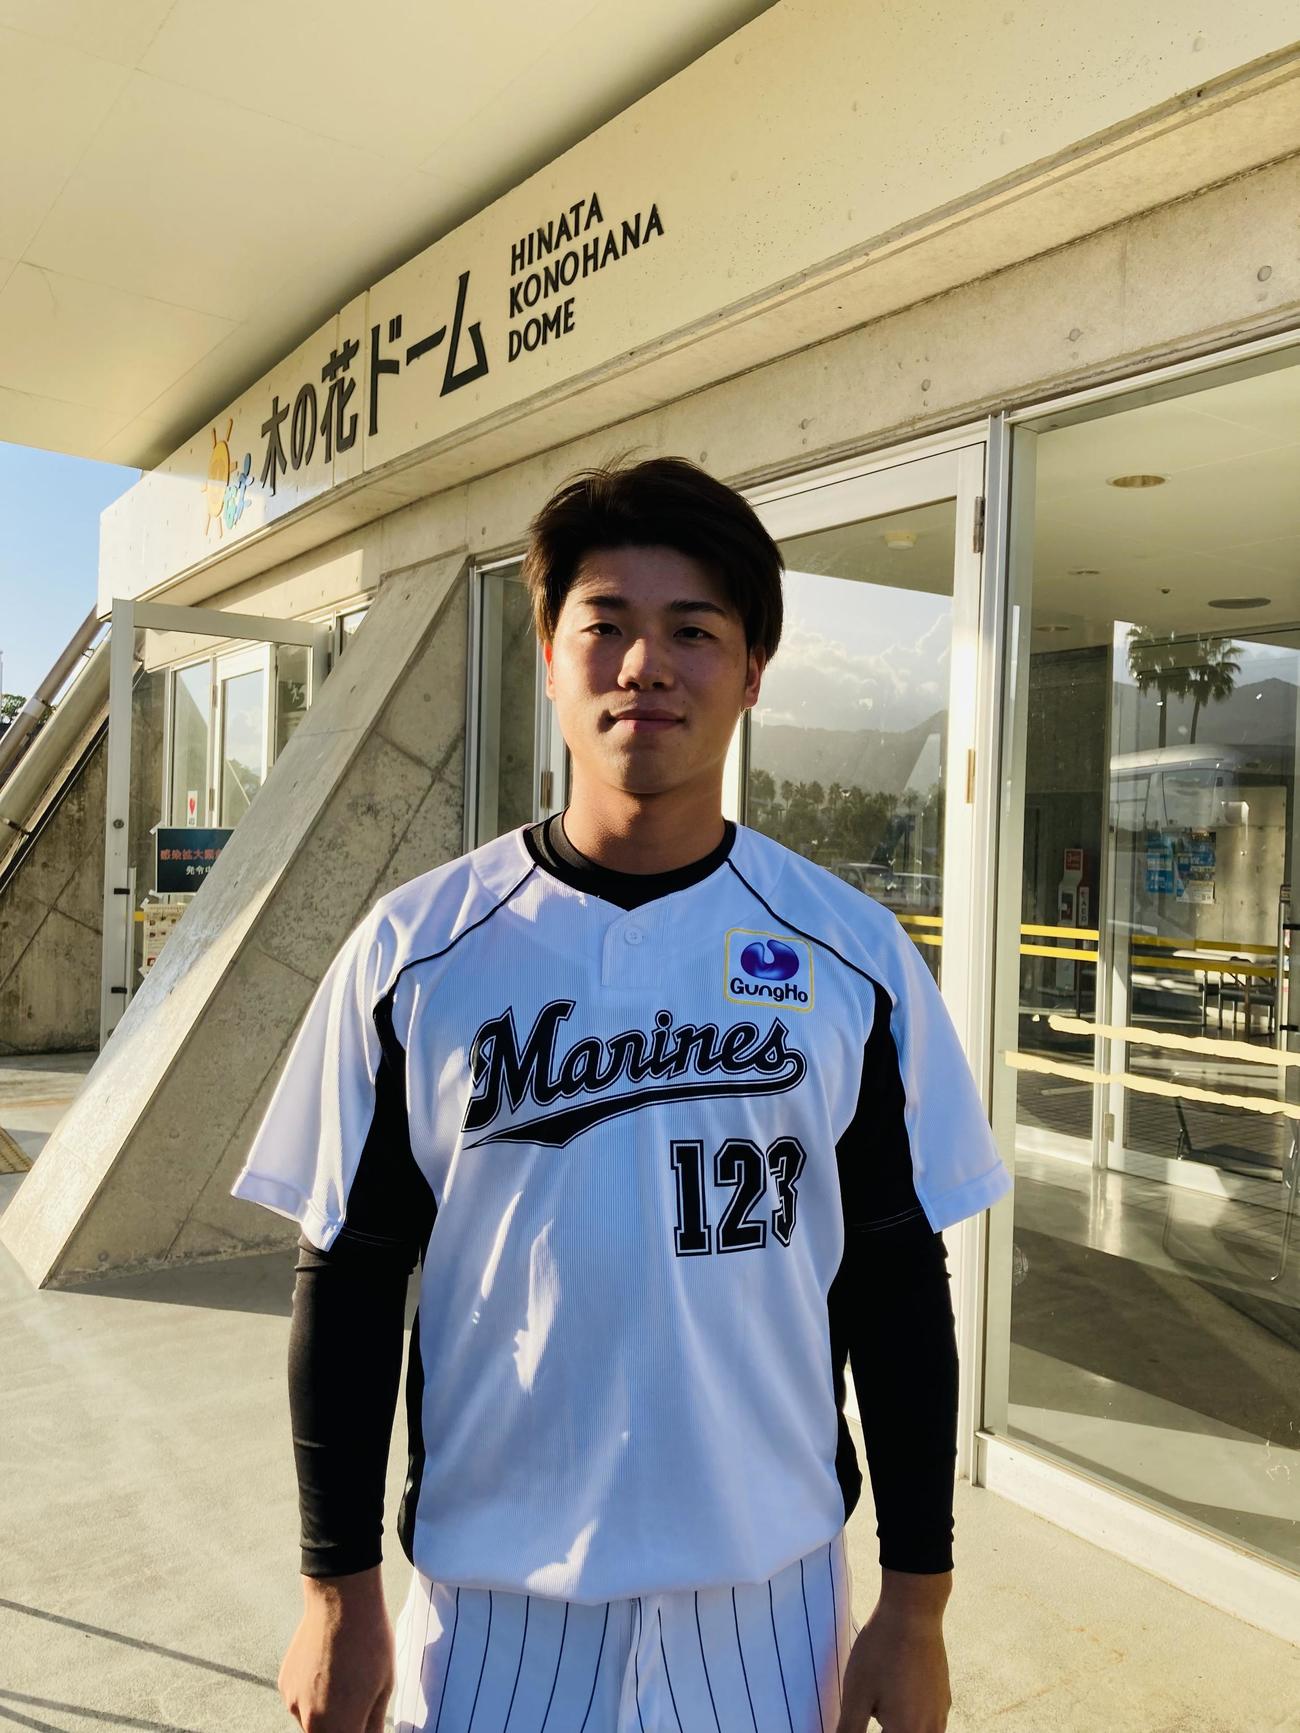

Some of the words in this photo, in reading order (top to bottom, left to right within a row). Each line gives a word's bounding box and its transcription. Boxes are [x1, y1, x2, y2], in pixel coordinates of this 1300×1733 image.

[508, 204, 665, 318] KONOHANA
[510, 192, 604, 277] HINATA
[260, 270, 490, 497] 木の花ドーム
[508, 297, 576, 363] DOME
[730, 977, 808, 1004] GungHo
[461, 999, 807, 1149] Marines
[670, 1136, 807, 1257] 123
